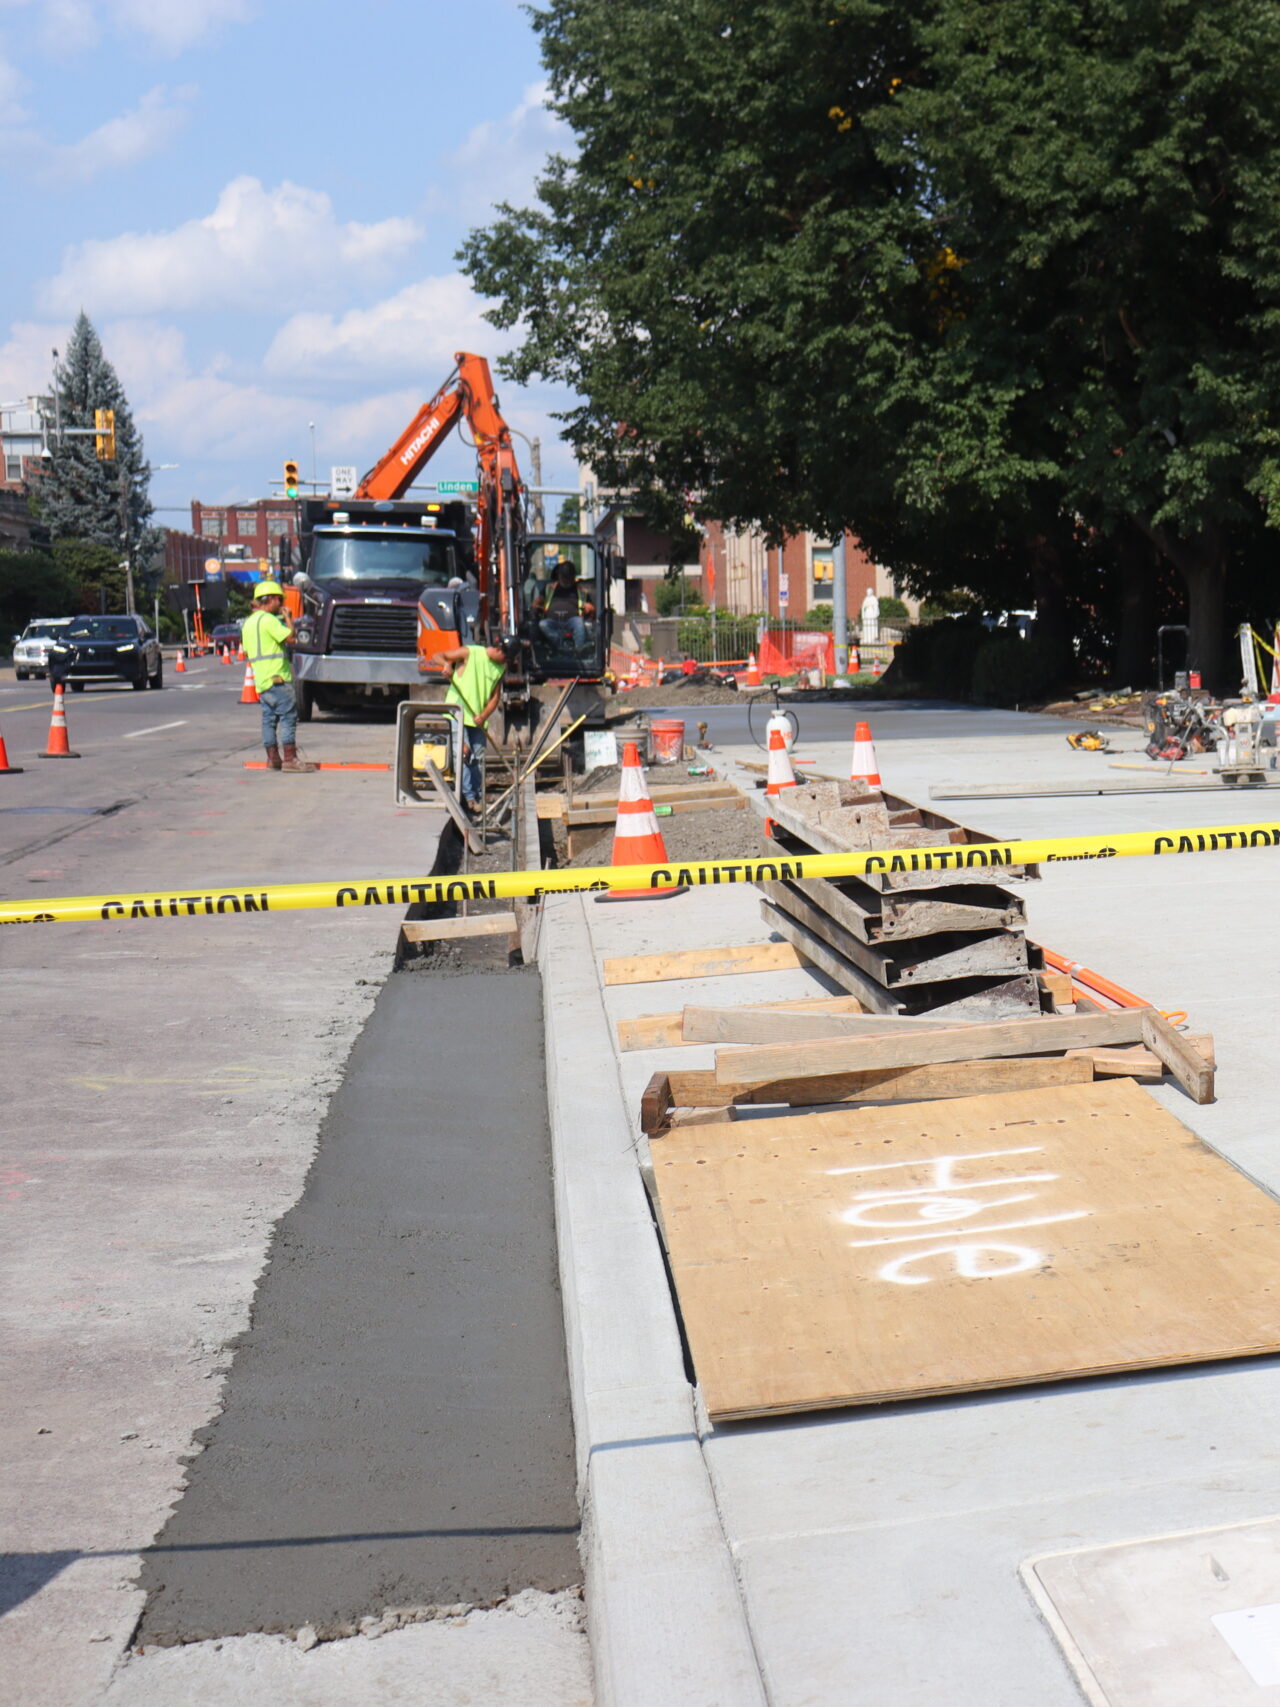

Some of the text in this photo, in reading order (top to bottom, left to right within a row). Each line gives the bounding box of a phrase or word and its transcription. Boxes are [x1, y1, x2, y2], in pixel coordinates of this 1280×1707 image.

[400, 417, 440, 465] HITACHI
[335, 475, 352, 484] WAY
[438, 482, 473, 491] Linden
[865, 848, 1012, 875] CAUTION
[650, 862, 804, 888] CAUTION
